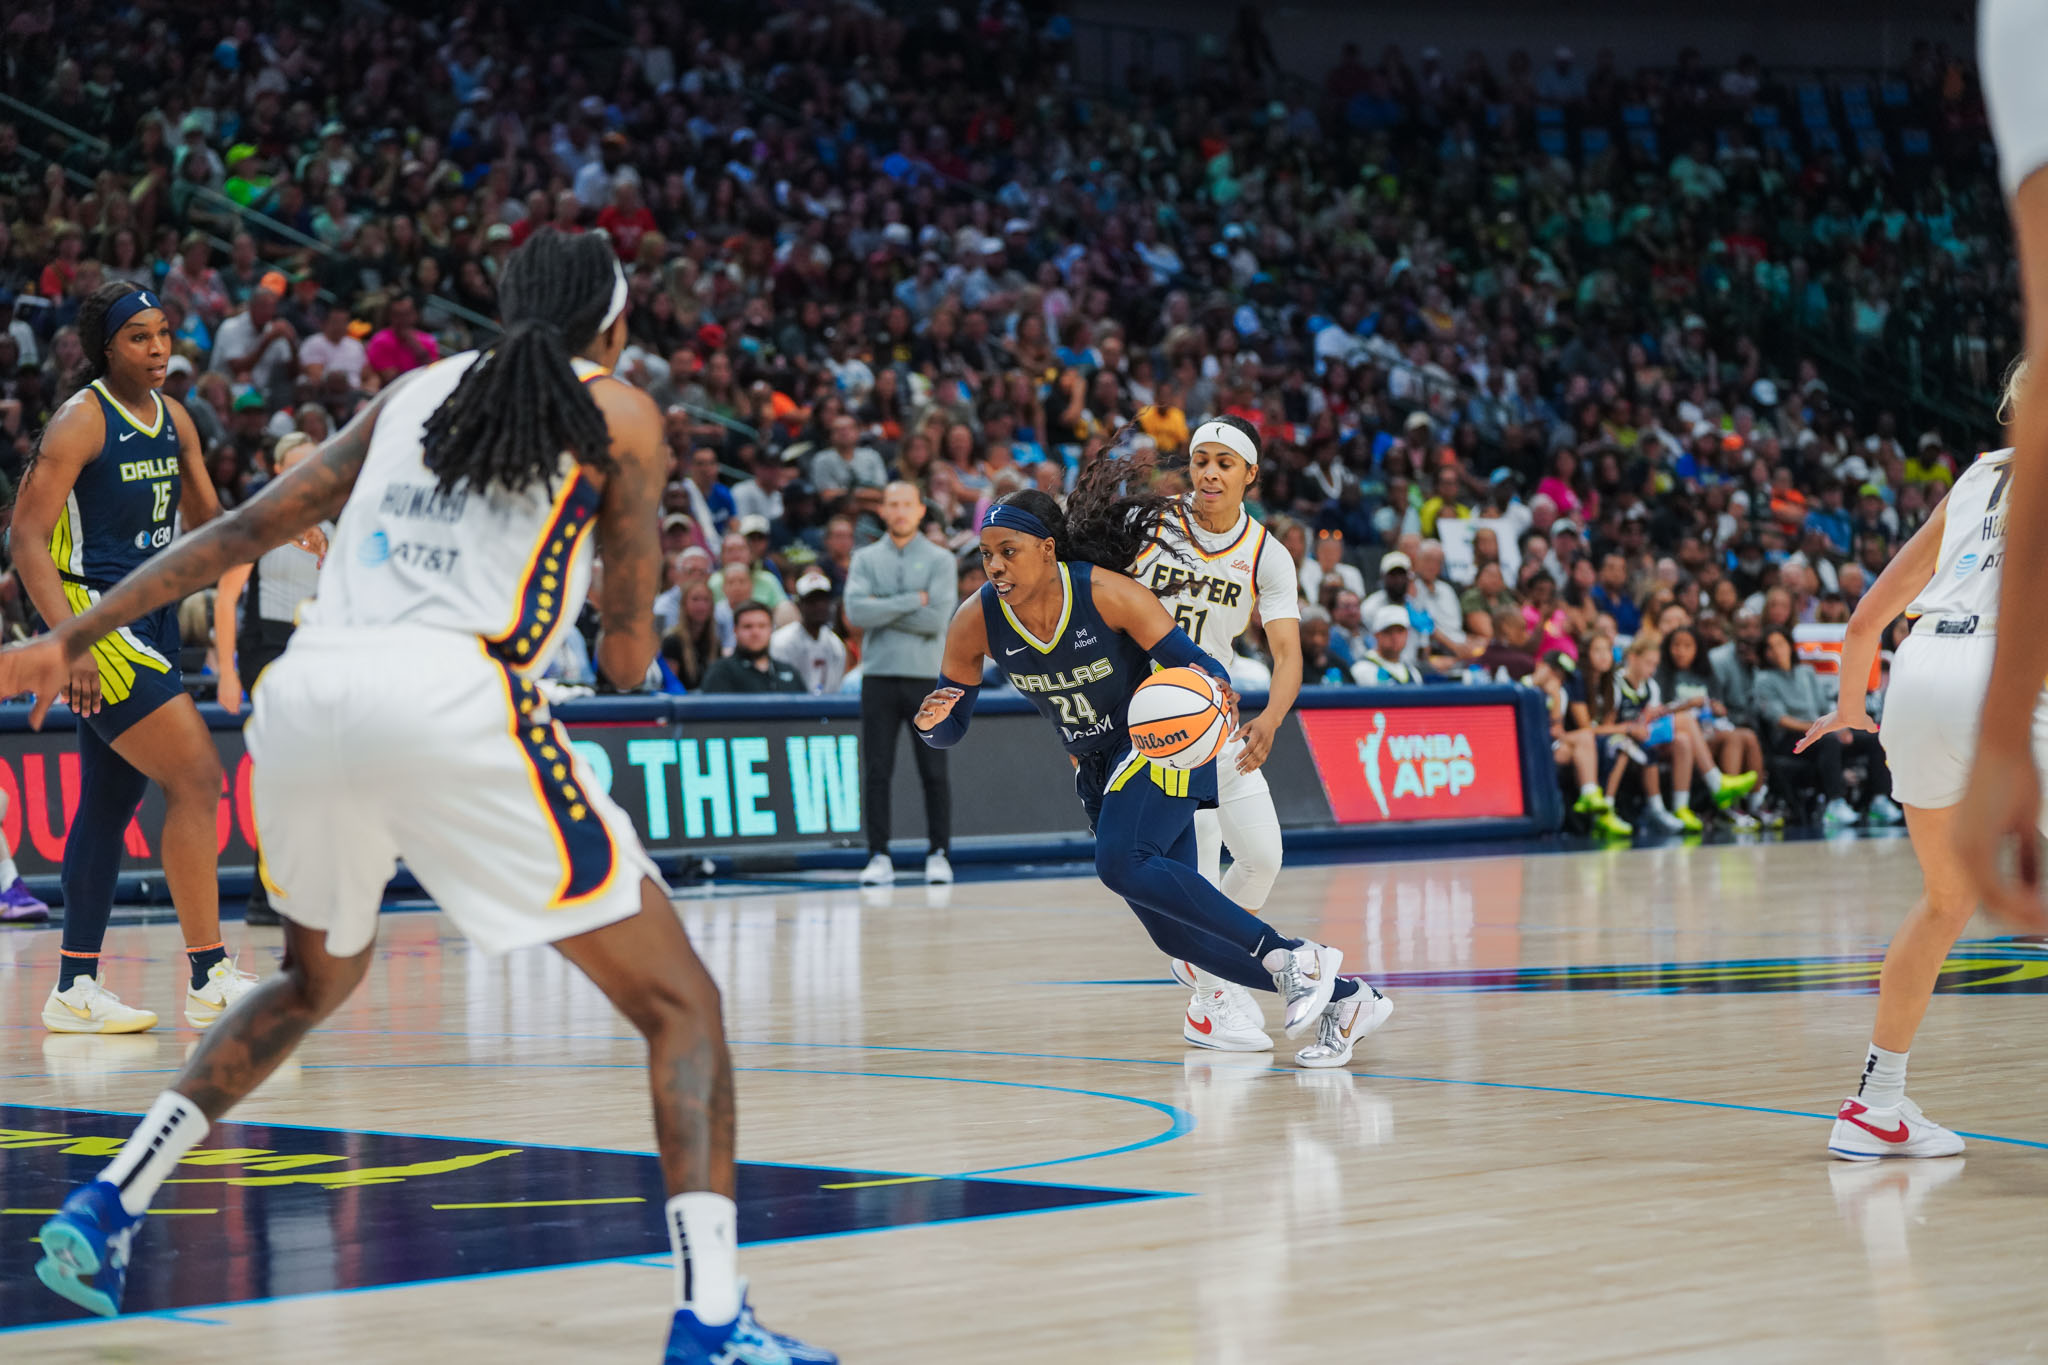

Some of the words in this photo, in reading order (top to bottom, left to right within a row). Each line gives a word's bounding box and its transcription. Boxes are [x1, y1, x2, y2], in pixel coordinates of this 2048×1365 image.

[120, 456, 180, 483] DALLA
[152, 480, 172, 523] 15
[1231, 560, 1252, 574] Lilly
[1150, 563, 1243, 608] FEVER
[1174, 603, 1209, 645] 51
[1073, 636, 1098, 650] Albert
[1009, 657, 1114, 693] DALLAS
[1048, 692, 1098, 725] 24
[1132, 729, 1190, 750] Wilson
[1387, 733, 1473, 761] WNBA
[626, 736, 778, 840] THE
[786, 734, 862, 834] W
[1392, 760, 1476, 798] APP
